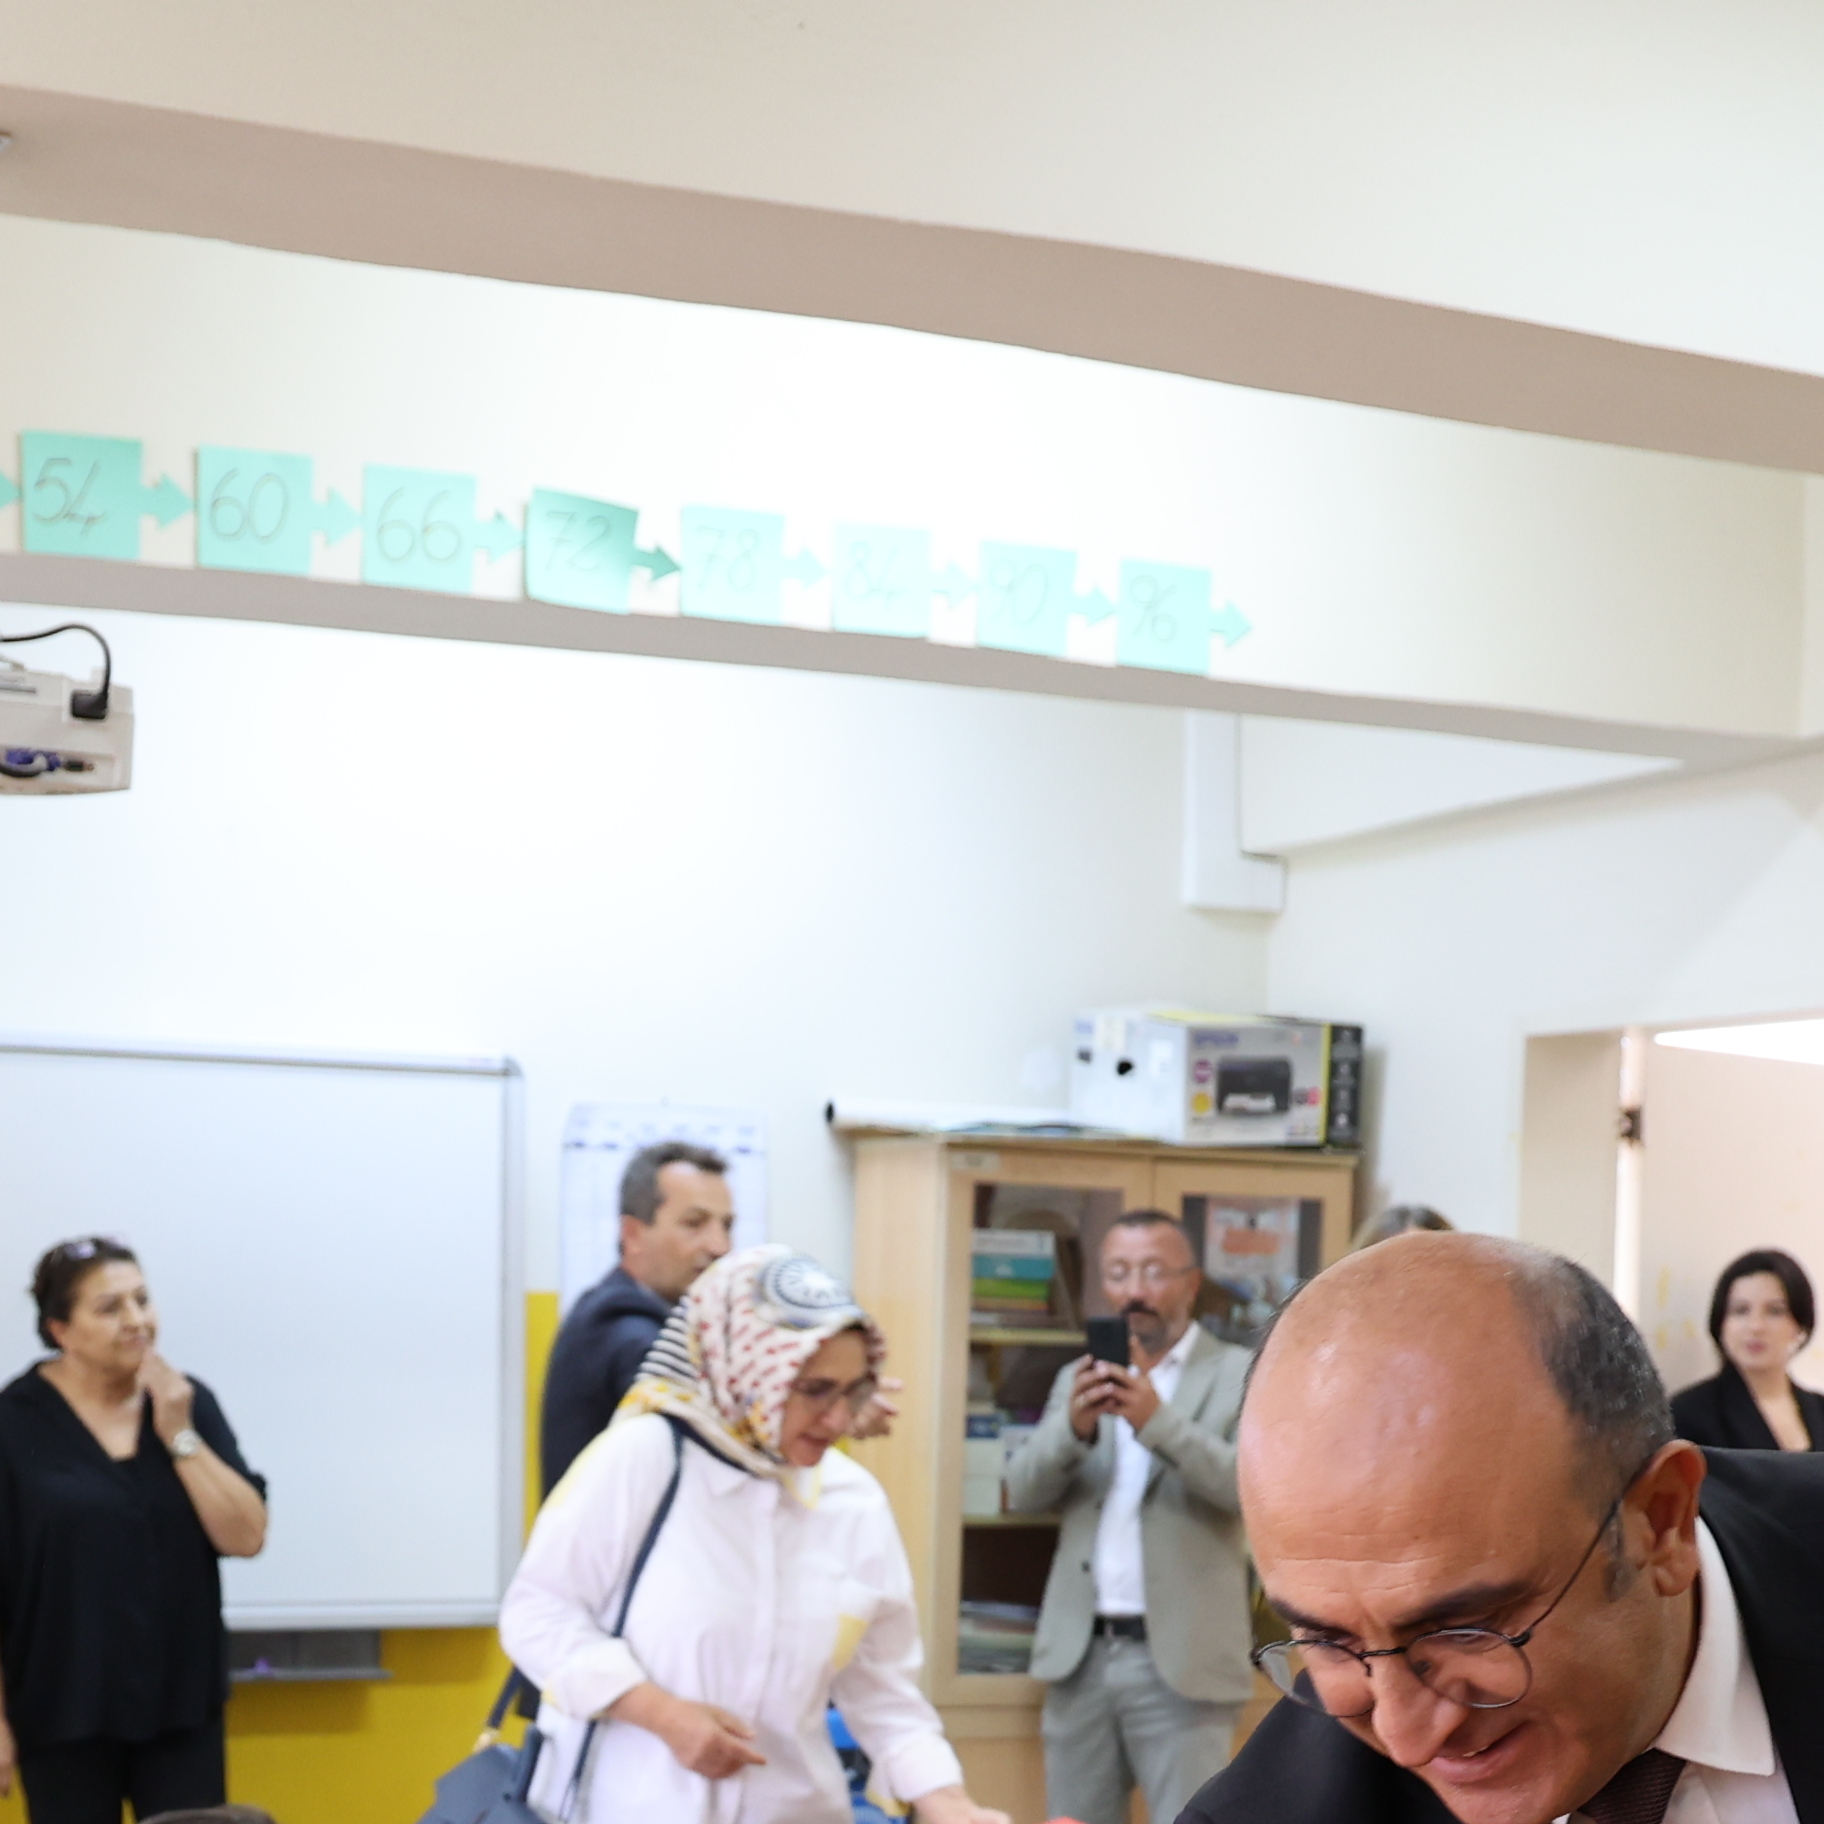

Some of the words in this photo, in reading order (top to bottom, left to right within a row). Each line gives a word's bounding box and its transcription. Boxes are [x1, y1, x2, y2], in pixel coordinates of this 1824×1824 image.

[31, 456, 109, 535] 54
[208, 466, 291, 545] 60
[375, 485, 464, 566] 66
[543, 509, 609, 572] 72
[694, 526, 758, 590] 78
[988, 557, 1051, 629] 90
[1127, 574, 1179, 644] 96
